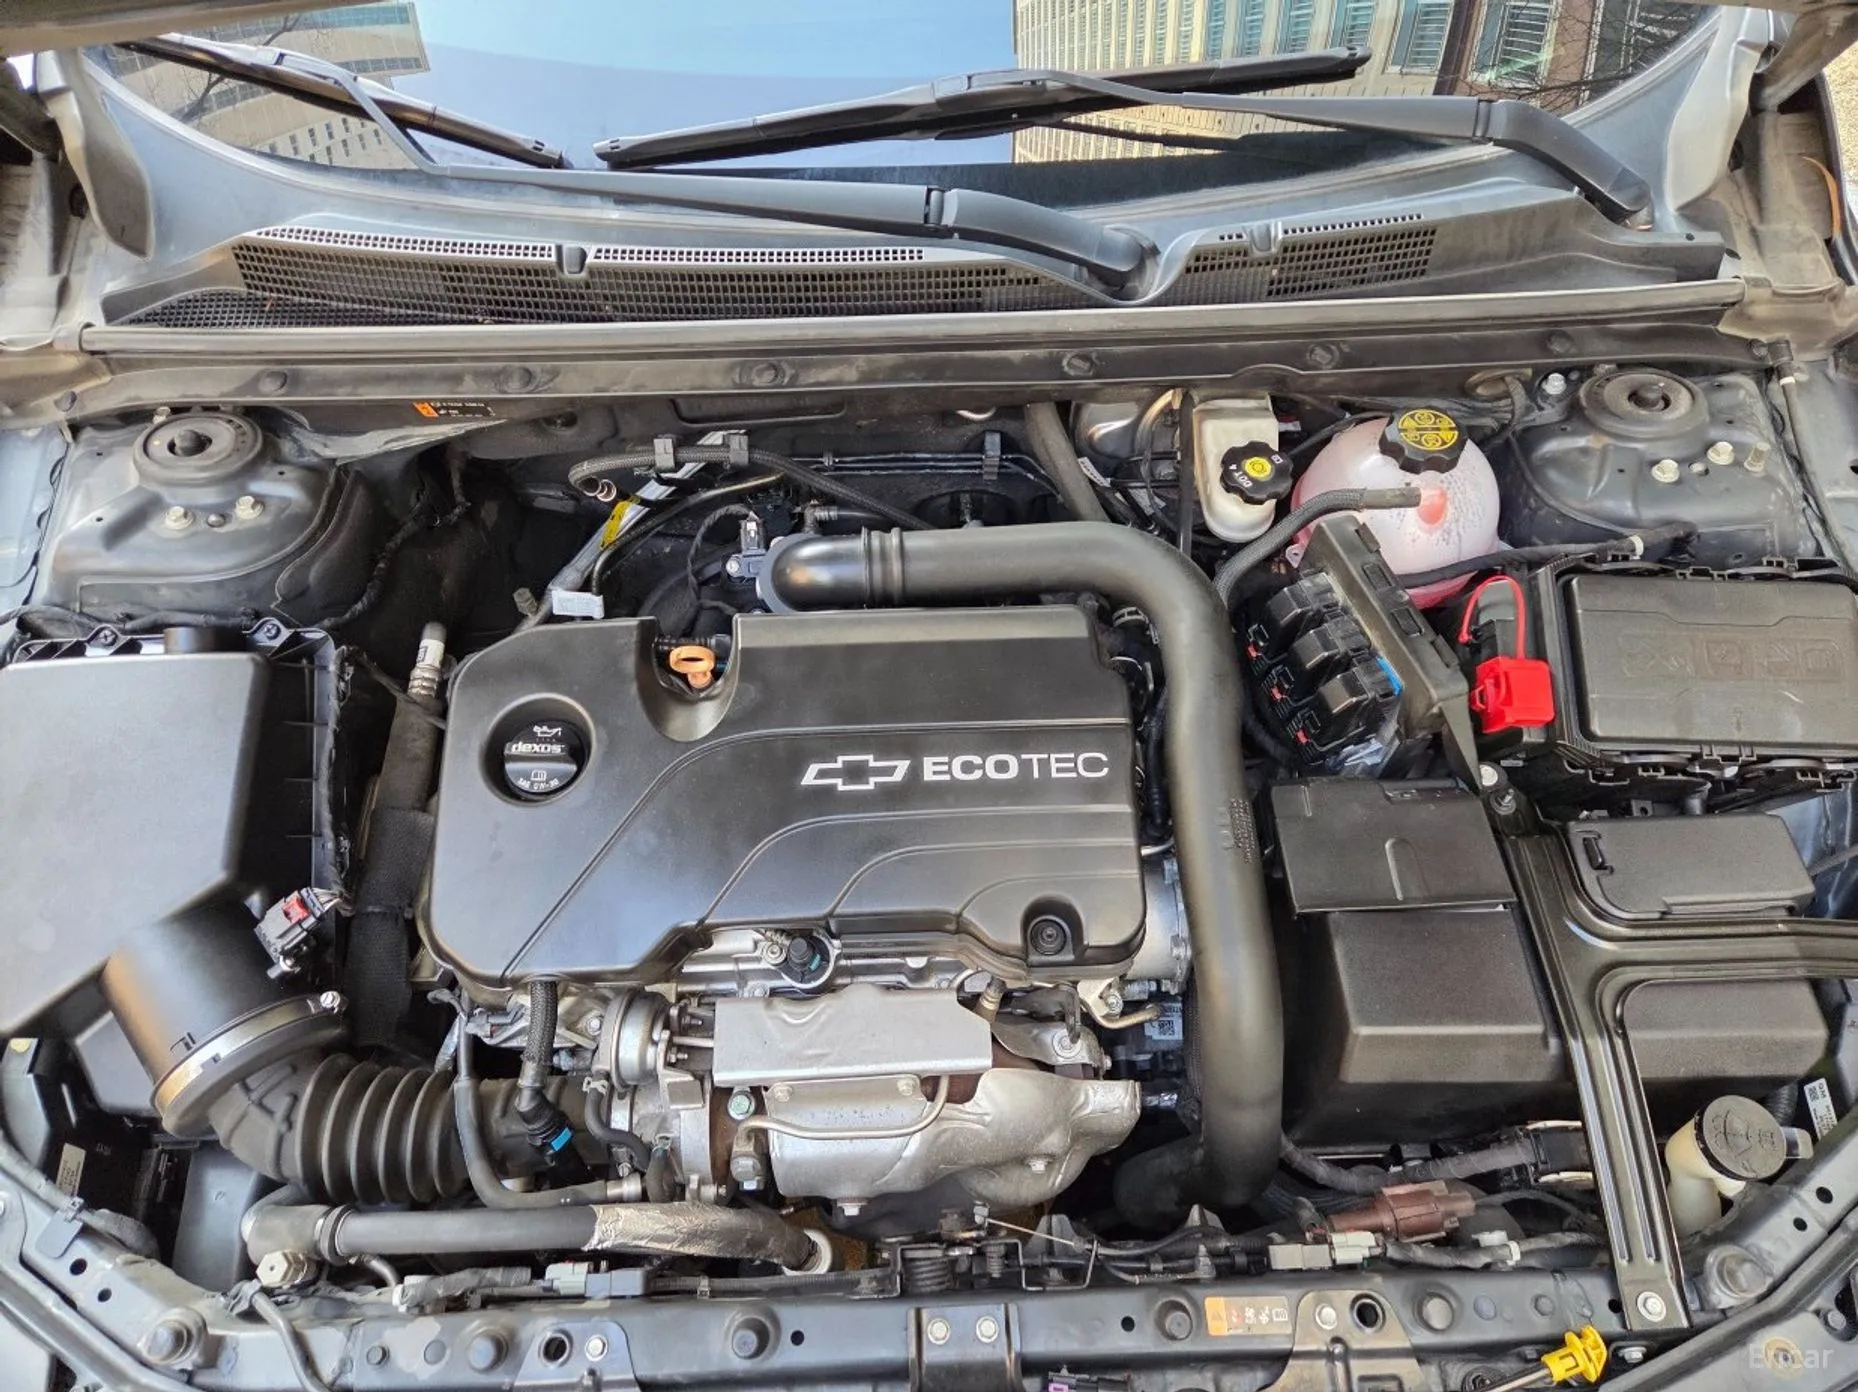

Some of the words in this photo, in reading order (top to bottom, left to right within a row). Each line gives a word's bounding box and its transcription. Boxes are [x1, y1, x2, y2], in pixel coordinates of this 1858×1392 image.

[1234, 471, 1253, 488] DOT
[511, 741, 563, 754] dexos
[923, 752, 1110, 781] ECOTEC
